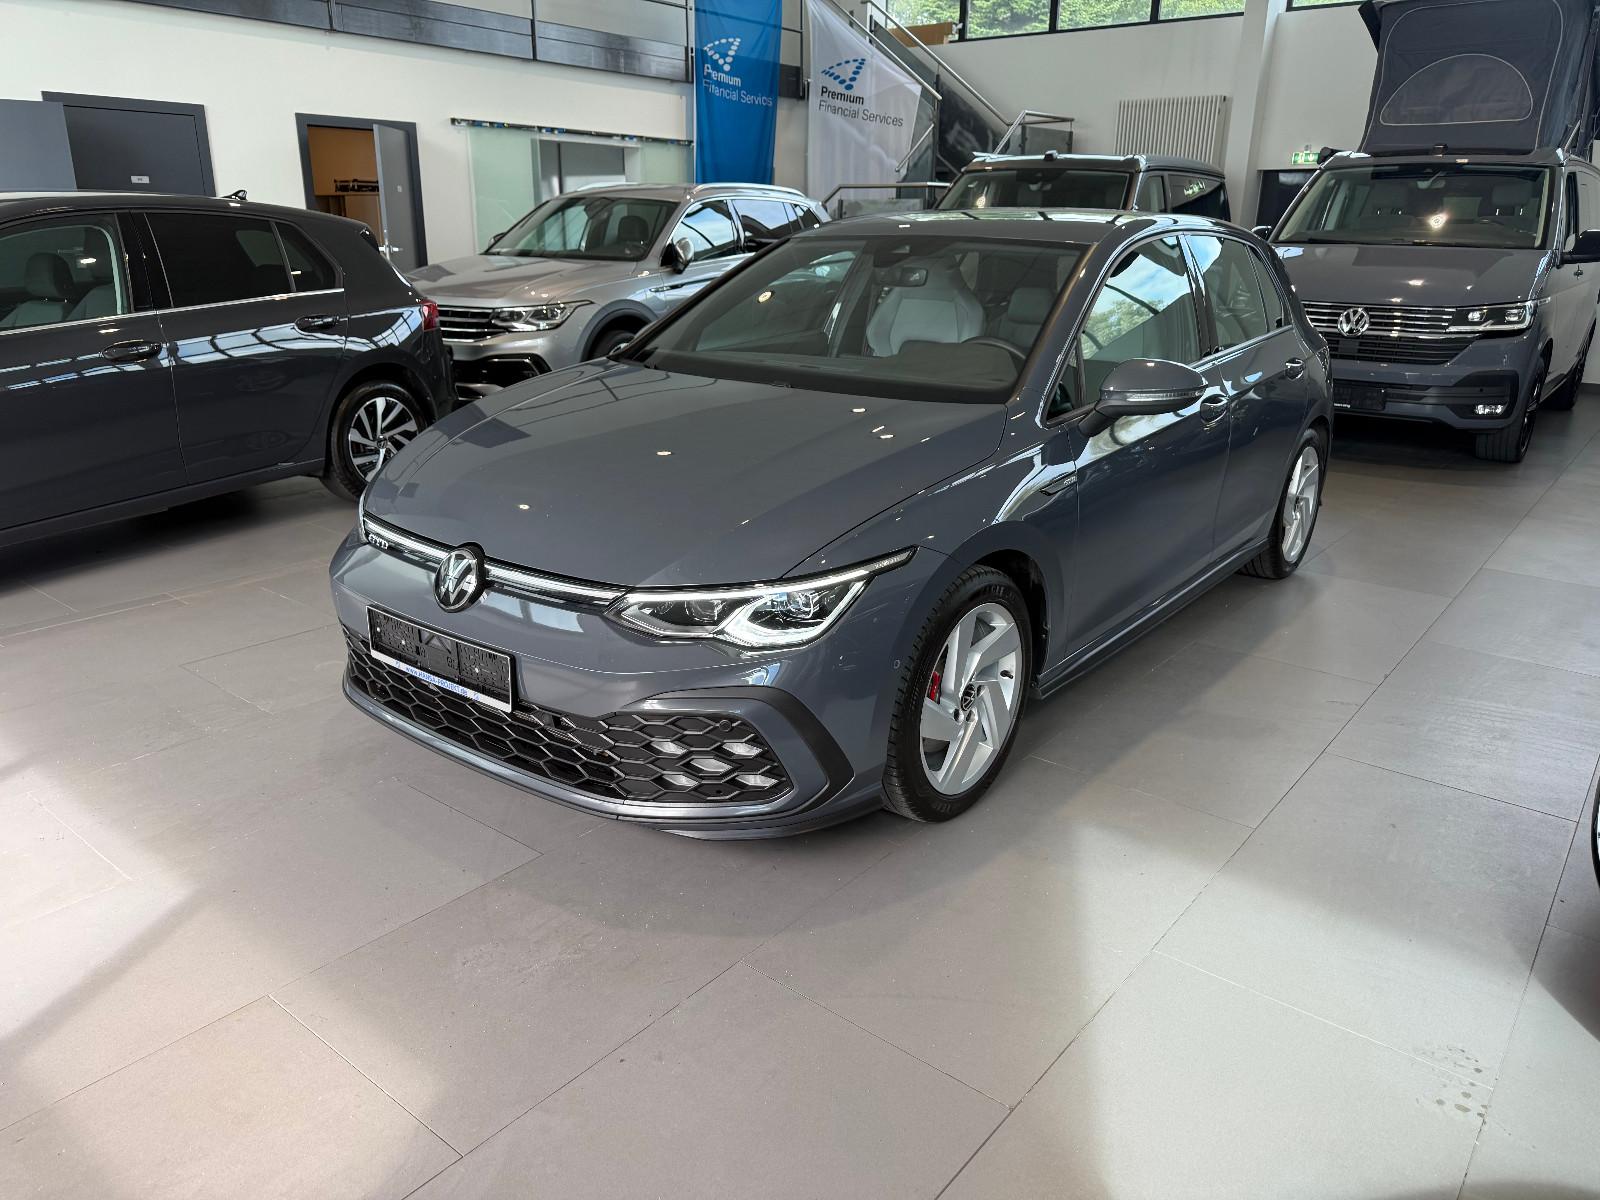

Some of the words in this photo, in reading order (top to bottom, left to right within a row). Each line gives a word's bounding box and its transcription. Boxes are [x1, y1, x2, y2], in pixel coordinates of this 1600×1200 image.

[704, 63, 742, 87] Pemium
[740, 90, 773, 107] Servics
[820, 85, 865, 105] Premium
[818, 100, 860, 119] Financial
[861, 108, 904, 127] Services
